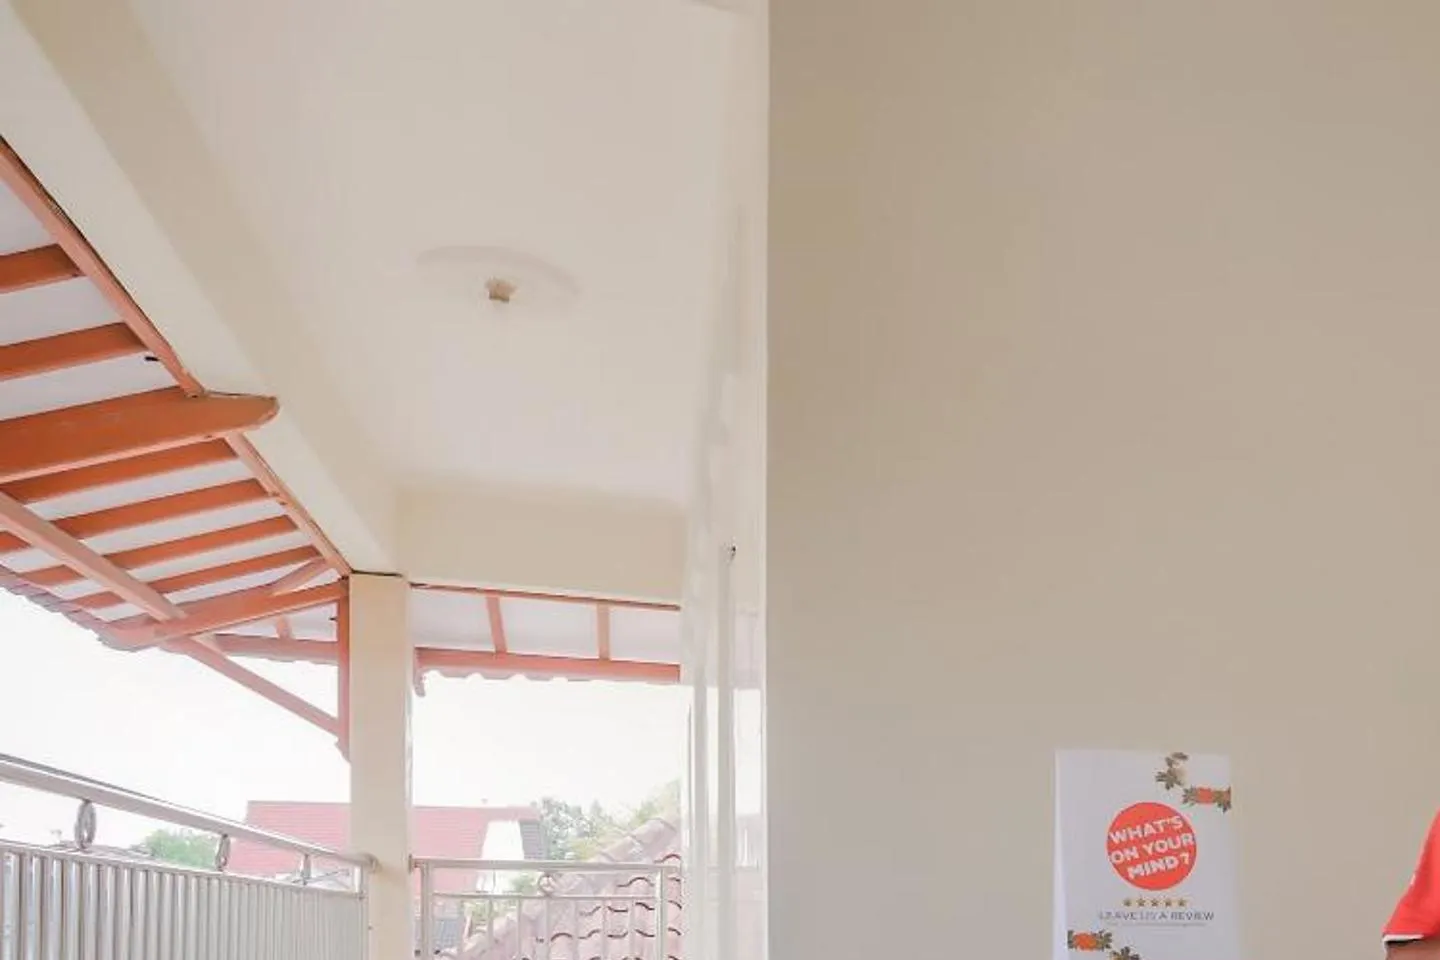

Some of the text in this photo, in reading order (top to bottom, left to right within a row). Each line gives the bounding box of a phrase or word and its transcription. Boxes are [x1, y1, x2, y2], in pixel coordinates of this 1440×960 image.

[1110, 815, 1183, 844] WHAT'S
[1111, 832, 1195, 865] ON YOUR
[1127, 852, 1190, 879] MIND?
[1170, 911, 1215, 921] REVIEW
